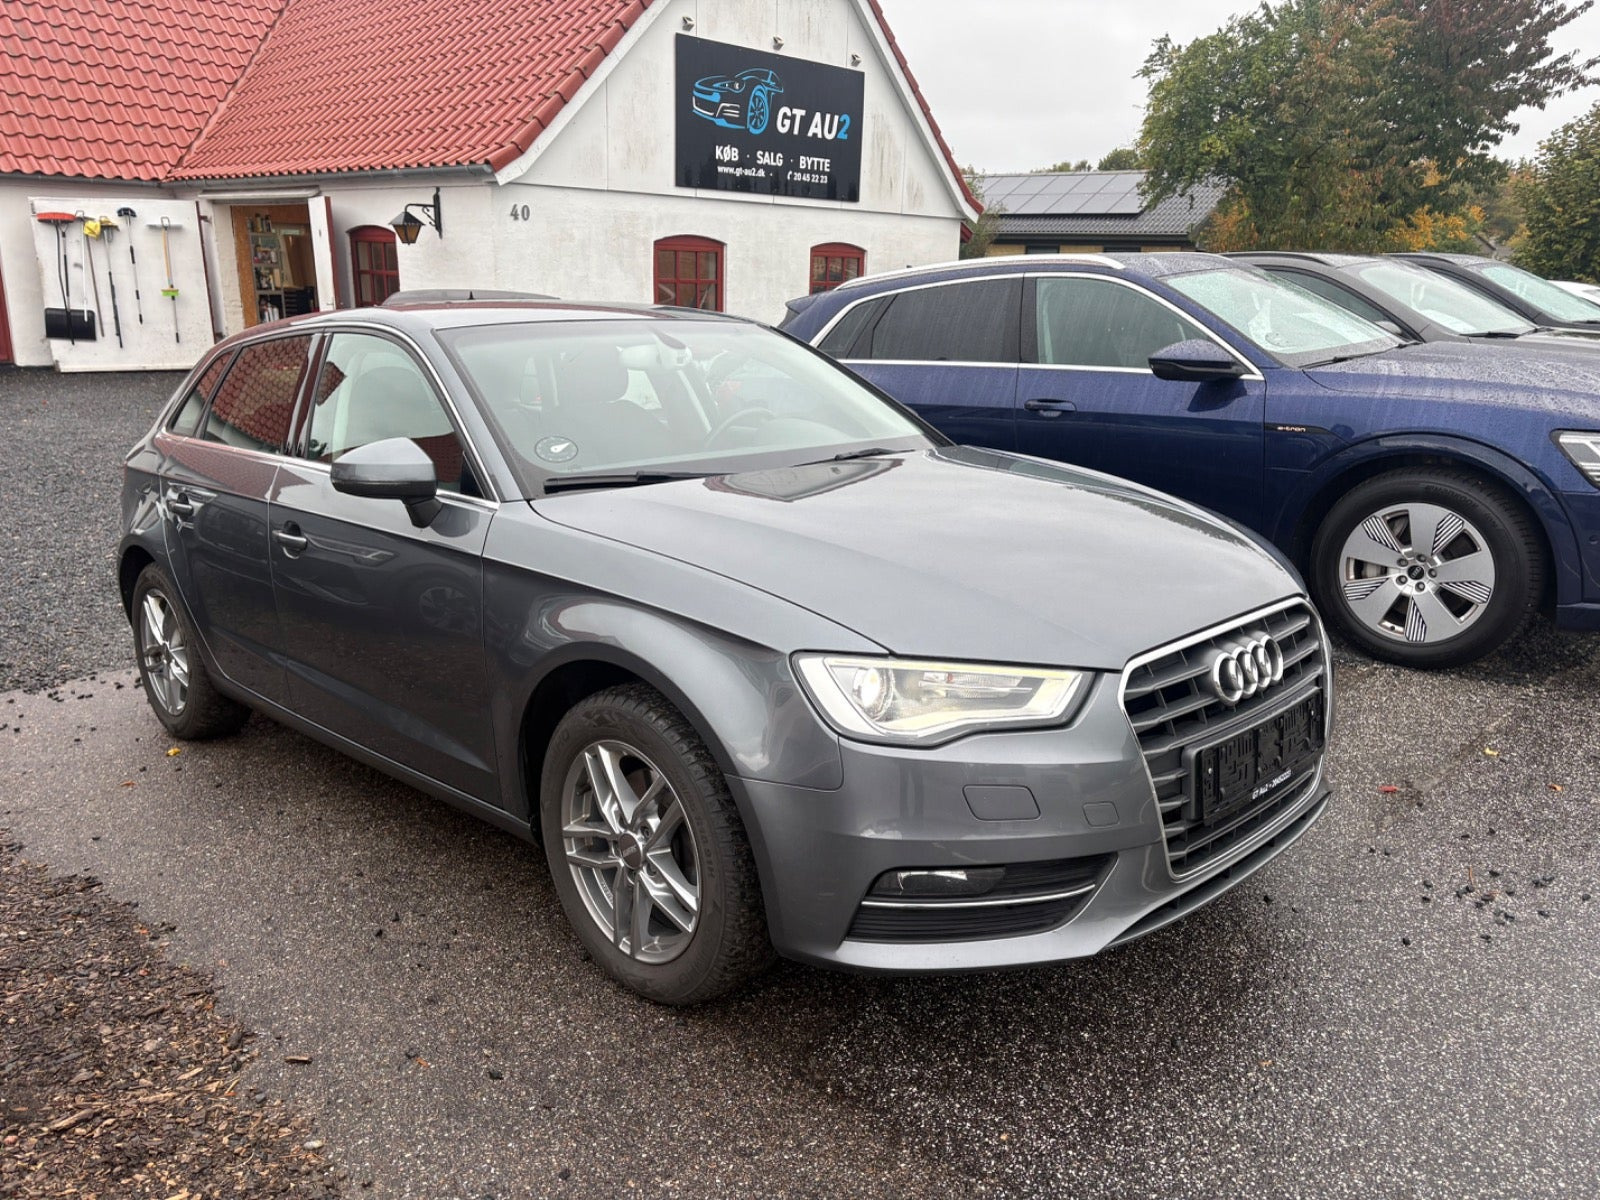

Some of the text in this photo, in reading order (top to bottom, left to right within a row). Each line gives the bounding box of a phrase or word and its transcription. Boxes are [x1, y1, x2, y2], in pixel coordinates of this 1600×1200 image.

[777, 106, 851, 140] GT AU2
[715, 145, 831, 172] KØB SALG BYTTE
[717, 165, 766, 178] www.gt-au2.dk
[510, 204, 530, 221] 40
